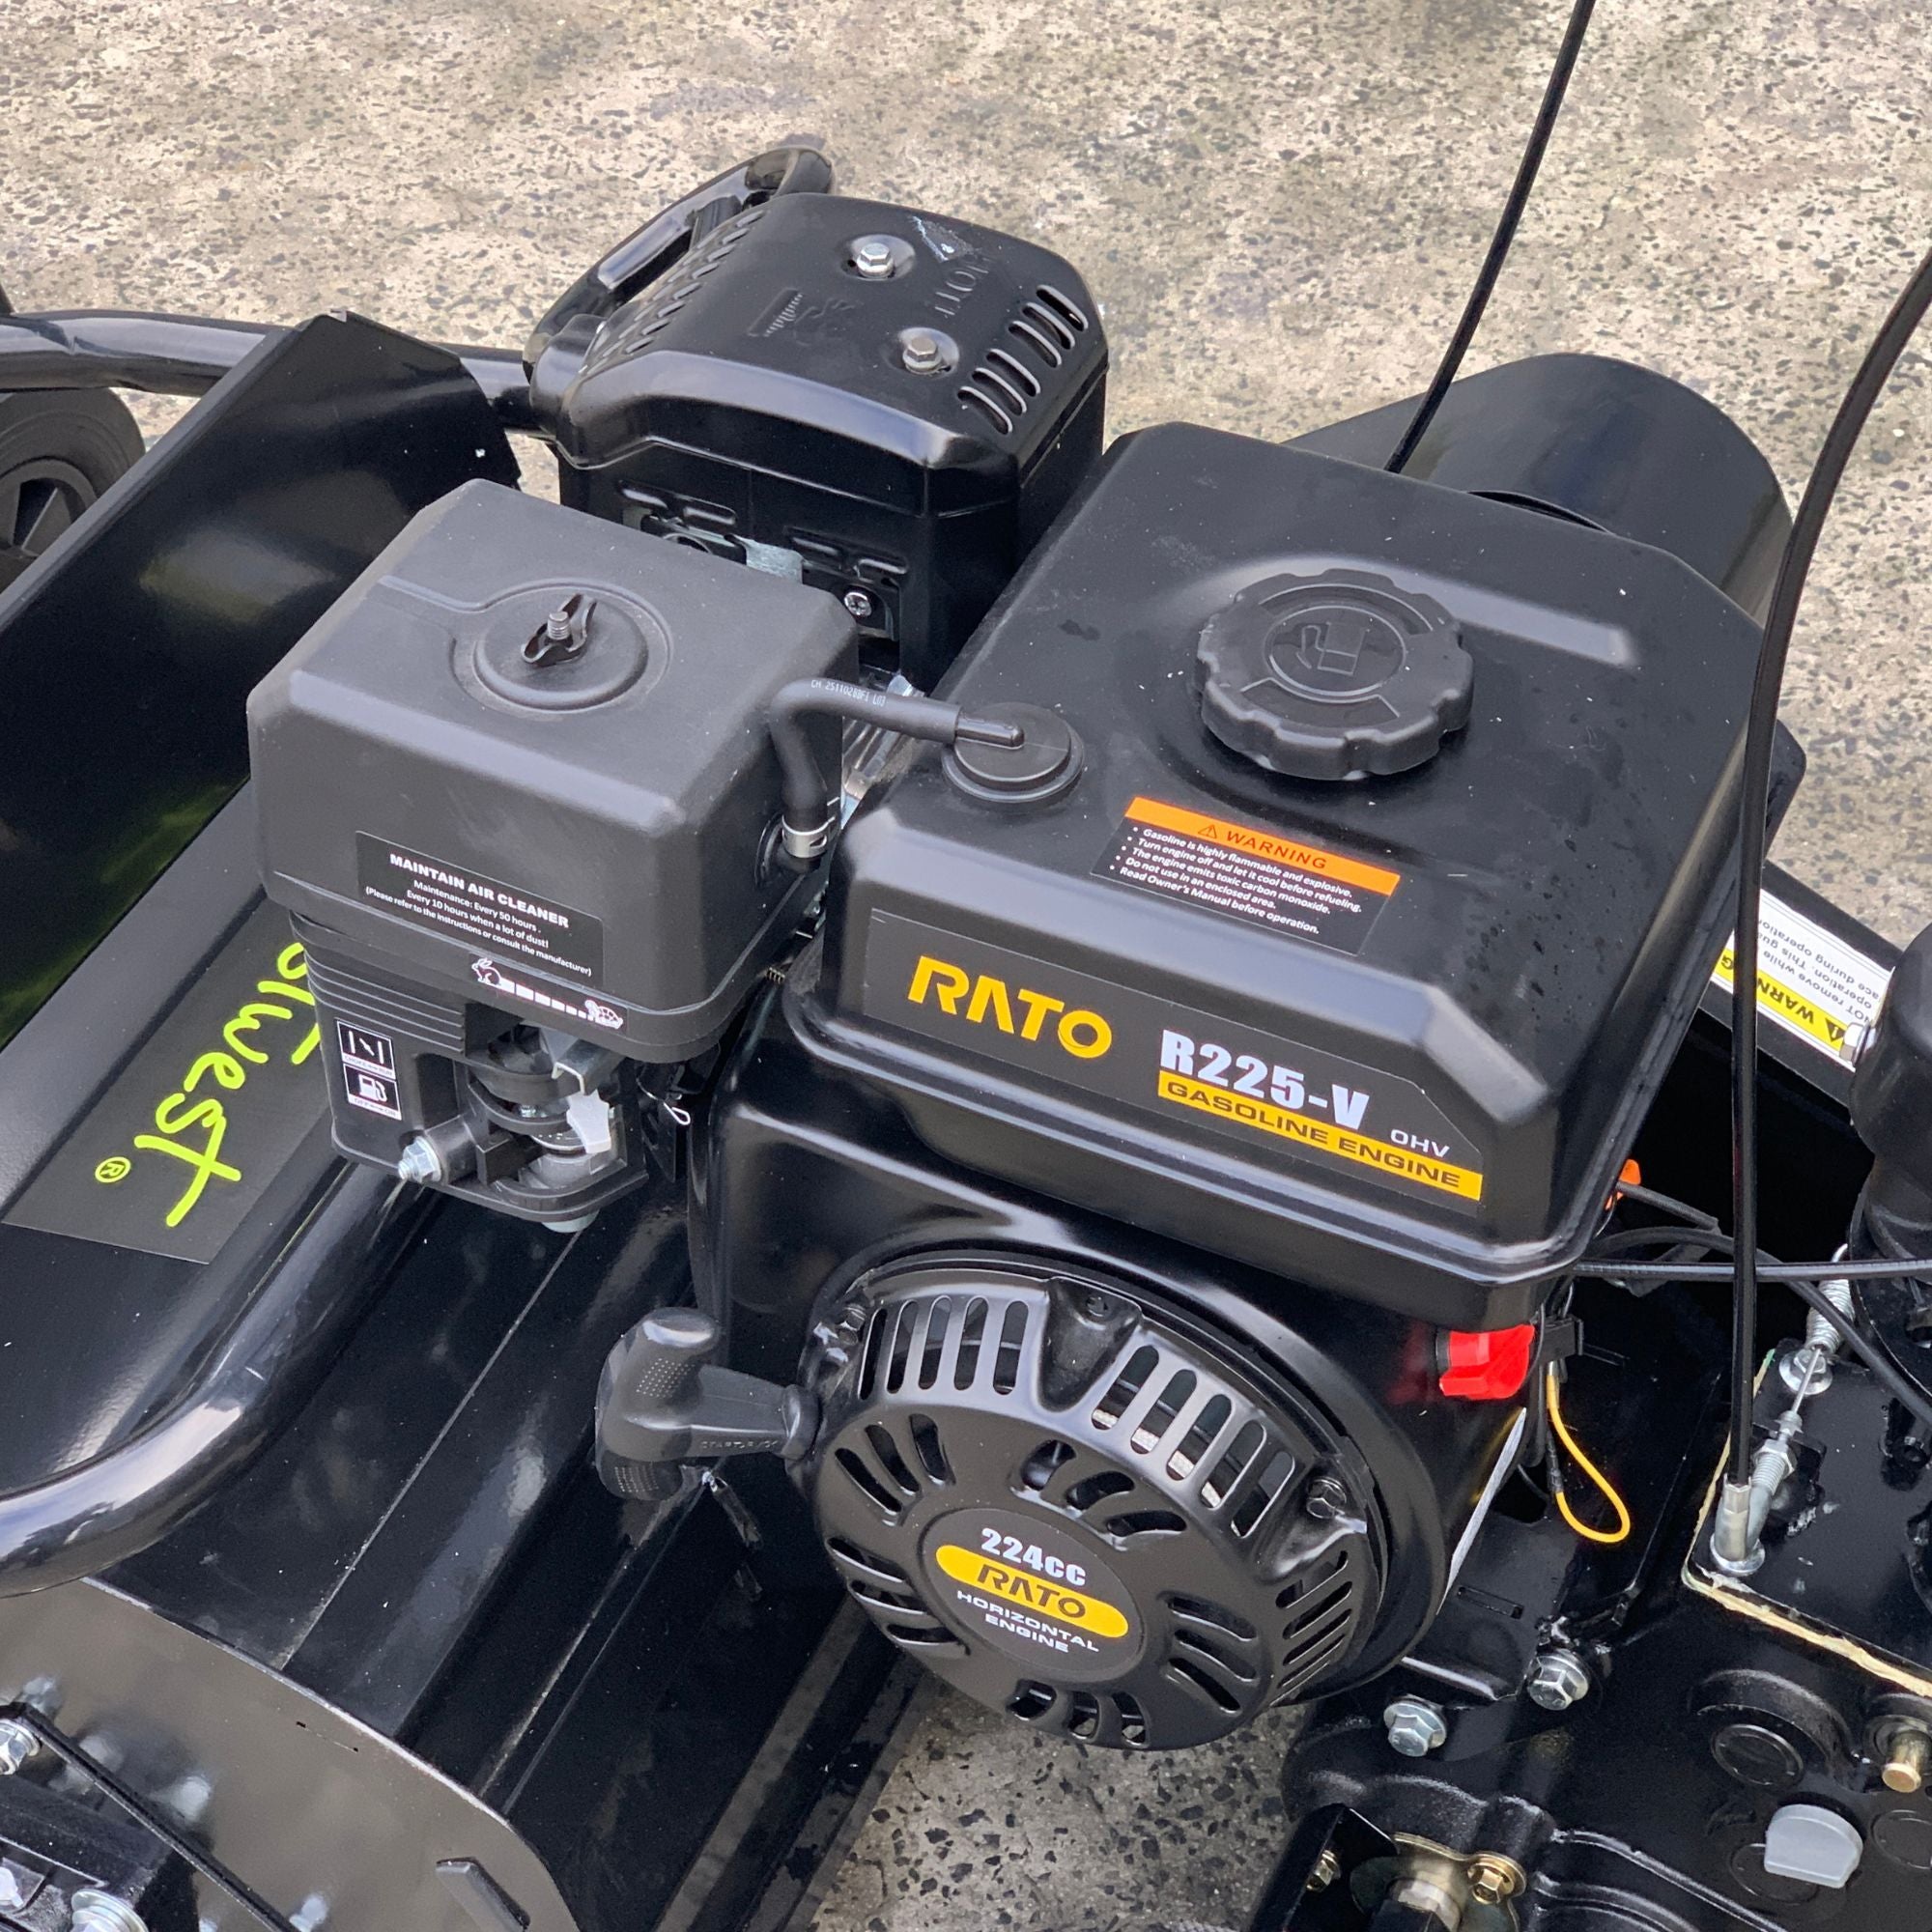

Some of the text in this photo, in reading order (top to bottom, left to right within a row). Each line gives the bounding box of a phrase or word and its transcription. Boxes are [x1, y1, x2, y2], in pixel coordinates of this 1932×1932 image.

[1138, 837, 1361, 913] Turn engine off and let it cool before refueling.
[1143, 828, 1352, 897] Gasoline is highly flammable and explosive.
[1227, 830, 1326, 869] WARNING
[389, 853, 568, 927] MAINTAIN AIR CLEANER
[412, 879, 472, 908] Maintenance:
[473, 901, 498, 919] Every
[498, 910, 511, 923] 50
[1119, 866, 1319, 934] Read Owner's Manual before operation.
[1124, 856, 1276, 909] Do not use in an enclosed area.
[1132, 846, 1330, 914] The engine emits toxic carbon monoxide.
[365, 886, 592, 977] (Please refer to the instructions or consult the manufacturer)
[406, 889, 549, 949] Every 10 hours when a lot of dust!
[1763, 952, 1797, 976] while
[1781, 948, 1807, 969] This
[1815, 953, 1856, 984] during
[907, 954, 1113, 1060] RATO
[1720, 955, 1815, 1024] WARNG
[1799, 973, 1845, 1007] remove
[1857, 983, 1881, 1001] ace
[1160, 1030, 1452, 1158] R225-V OHV
[1167, 1081, 1461, 1189] GASOLINE ENGINE
[980, 1527, 1087, 1586] 224cc
[978, 1563, 1087, 1619] RATO
[956, 1590, 1099, 1653] HORIZONTAL
[984, 1613, 1068, 1653] ENGINE
